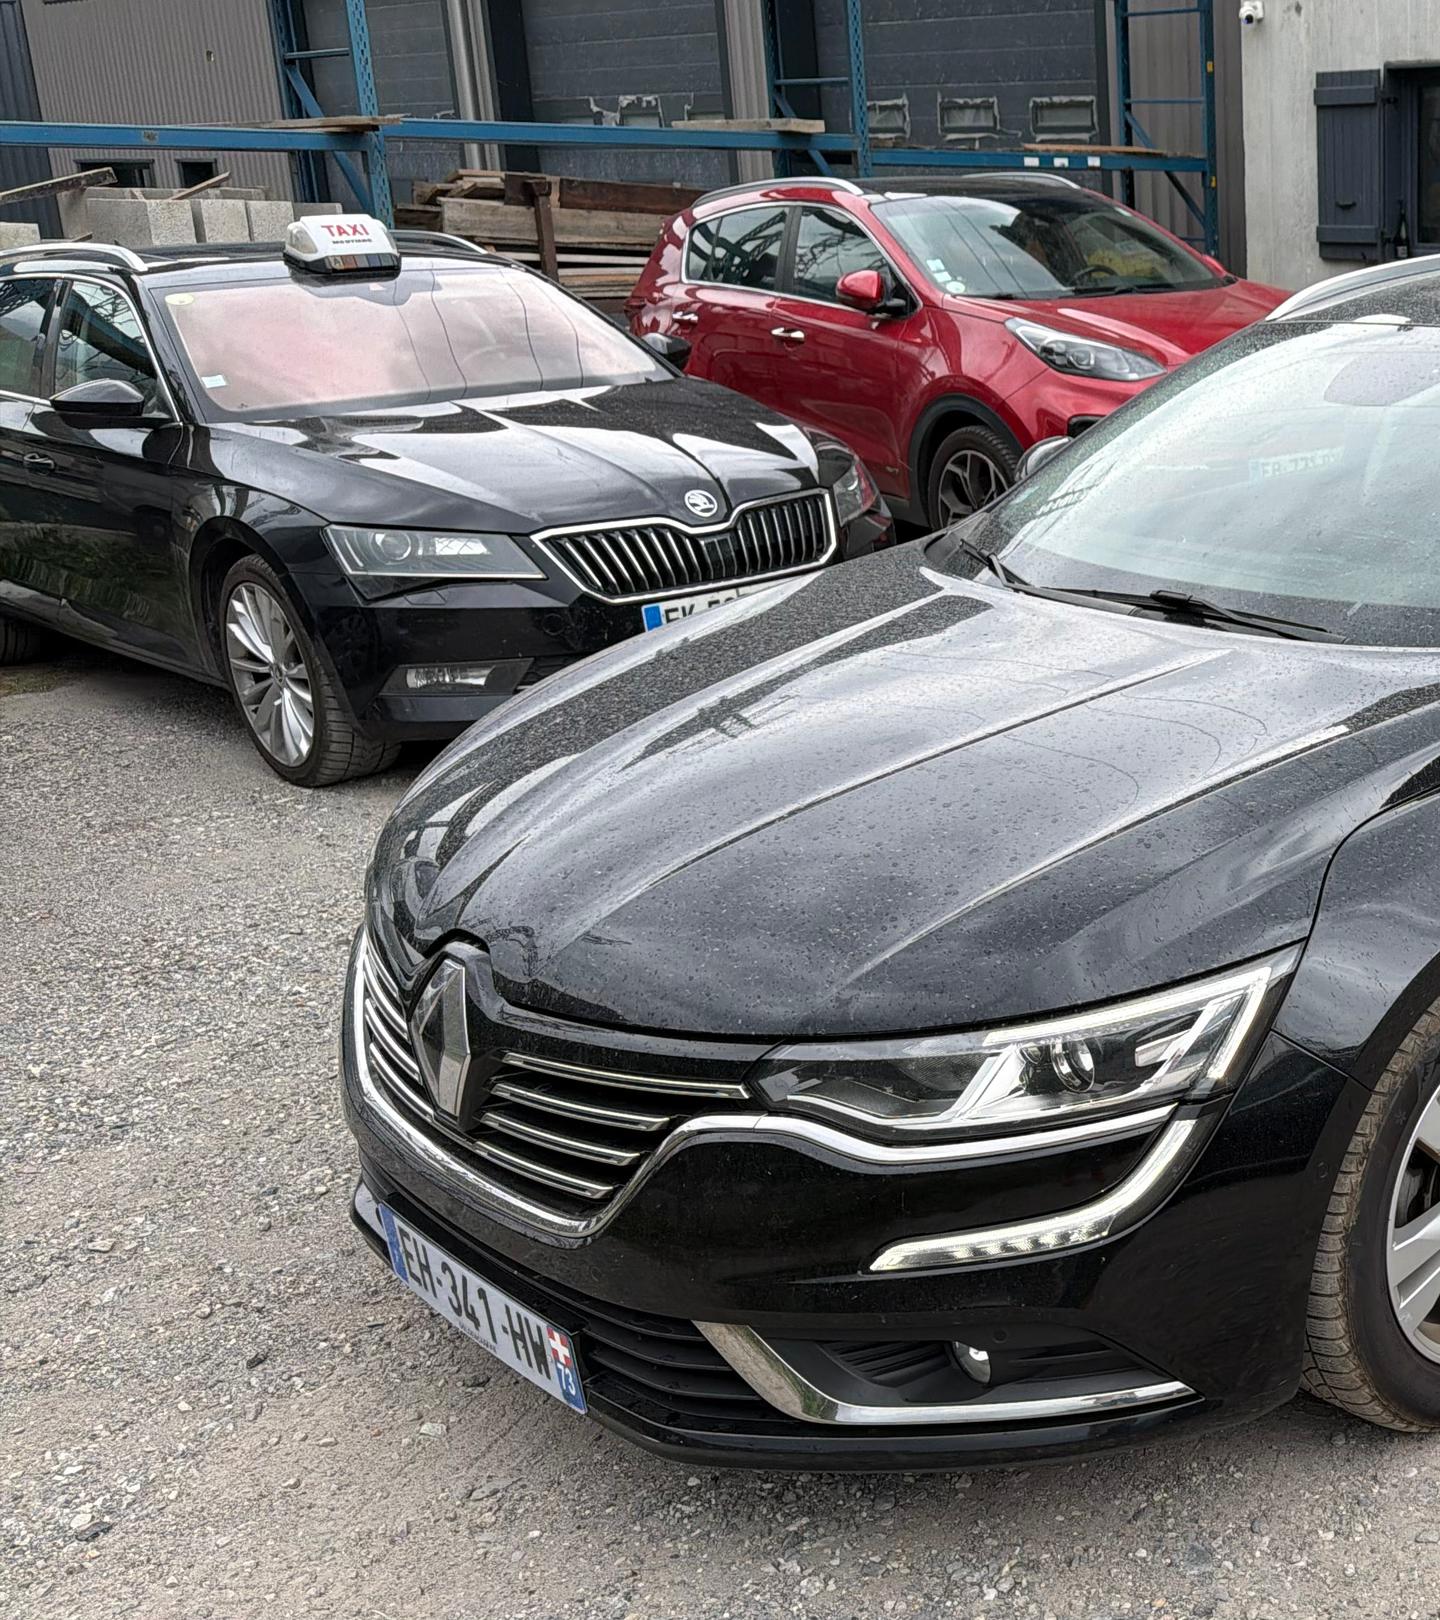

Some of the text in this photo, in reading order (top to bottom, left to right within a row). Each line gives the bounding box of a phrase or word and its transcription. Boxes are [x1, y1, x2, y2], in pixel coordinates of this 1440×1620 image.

[321, 224, 370, 238] TAXI
[396, 1226, 553, 1381] EH-341-HW
[556, 1363, 577, 1397] 73
